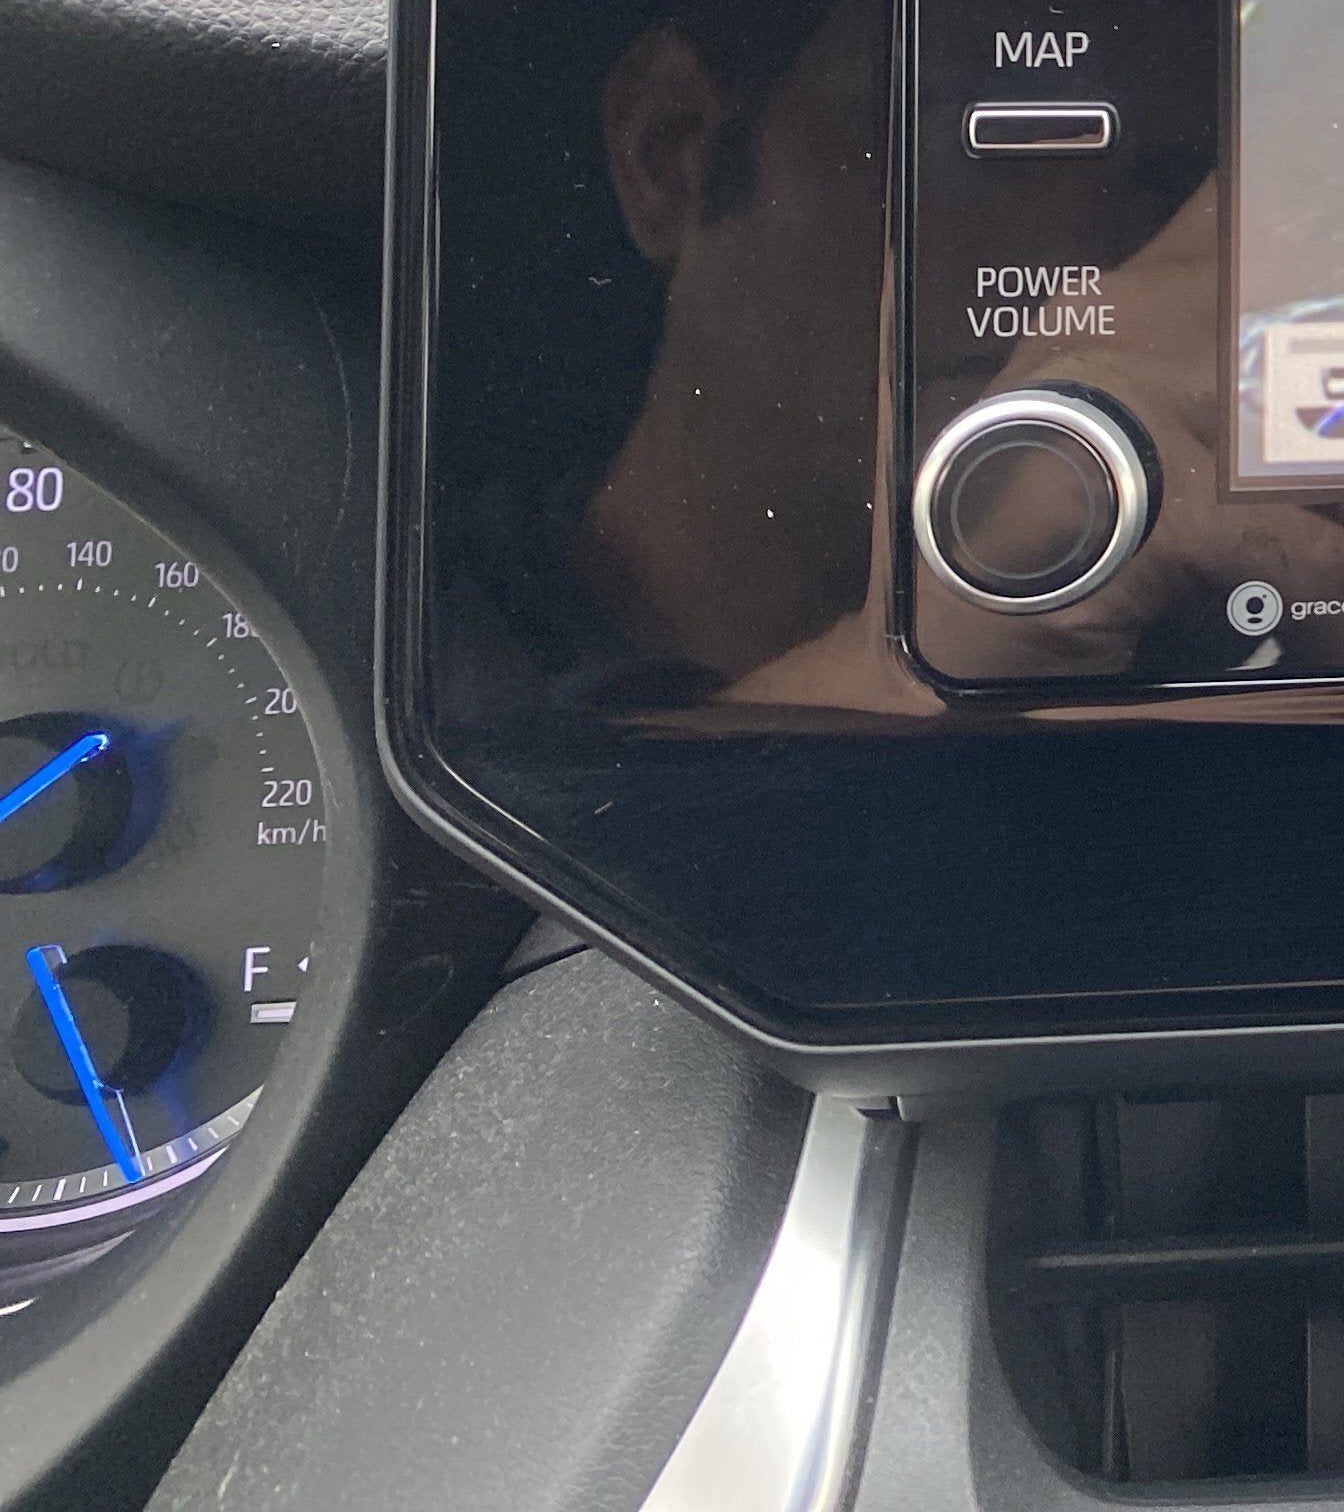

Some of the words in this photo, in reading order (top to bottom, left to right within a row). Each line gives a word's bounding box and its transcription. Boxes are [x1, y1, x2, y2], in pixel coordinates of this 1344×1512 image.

[994, 30, 1091, 69] MAP
[976, 265, 1103, 298] POWER
[966, 304, 1117, 338] VOLUME
[6, 467, 64, 512] 80
[66, 540, 113, 567] 140
[154, 561, 200, 588] 160
[222, 612, 260, 639] 18
[261, 780, 312, 808] 220
[256, 820, 326, 846] km/h
[243, 946, 272, 993] F
